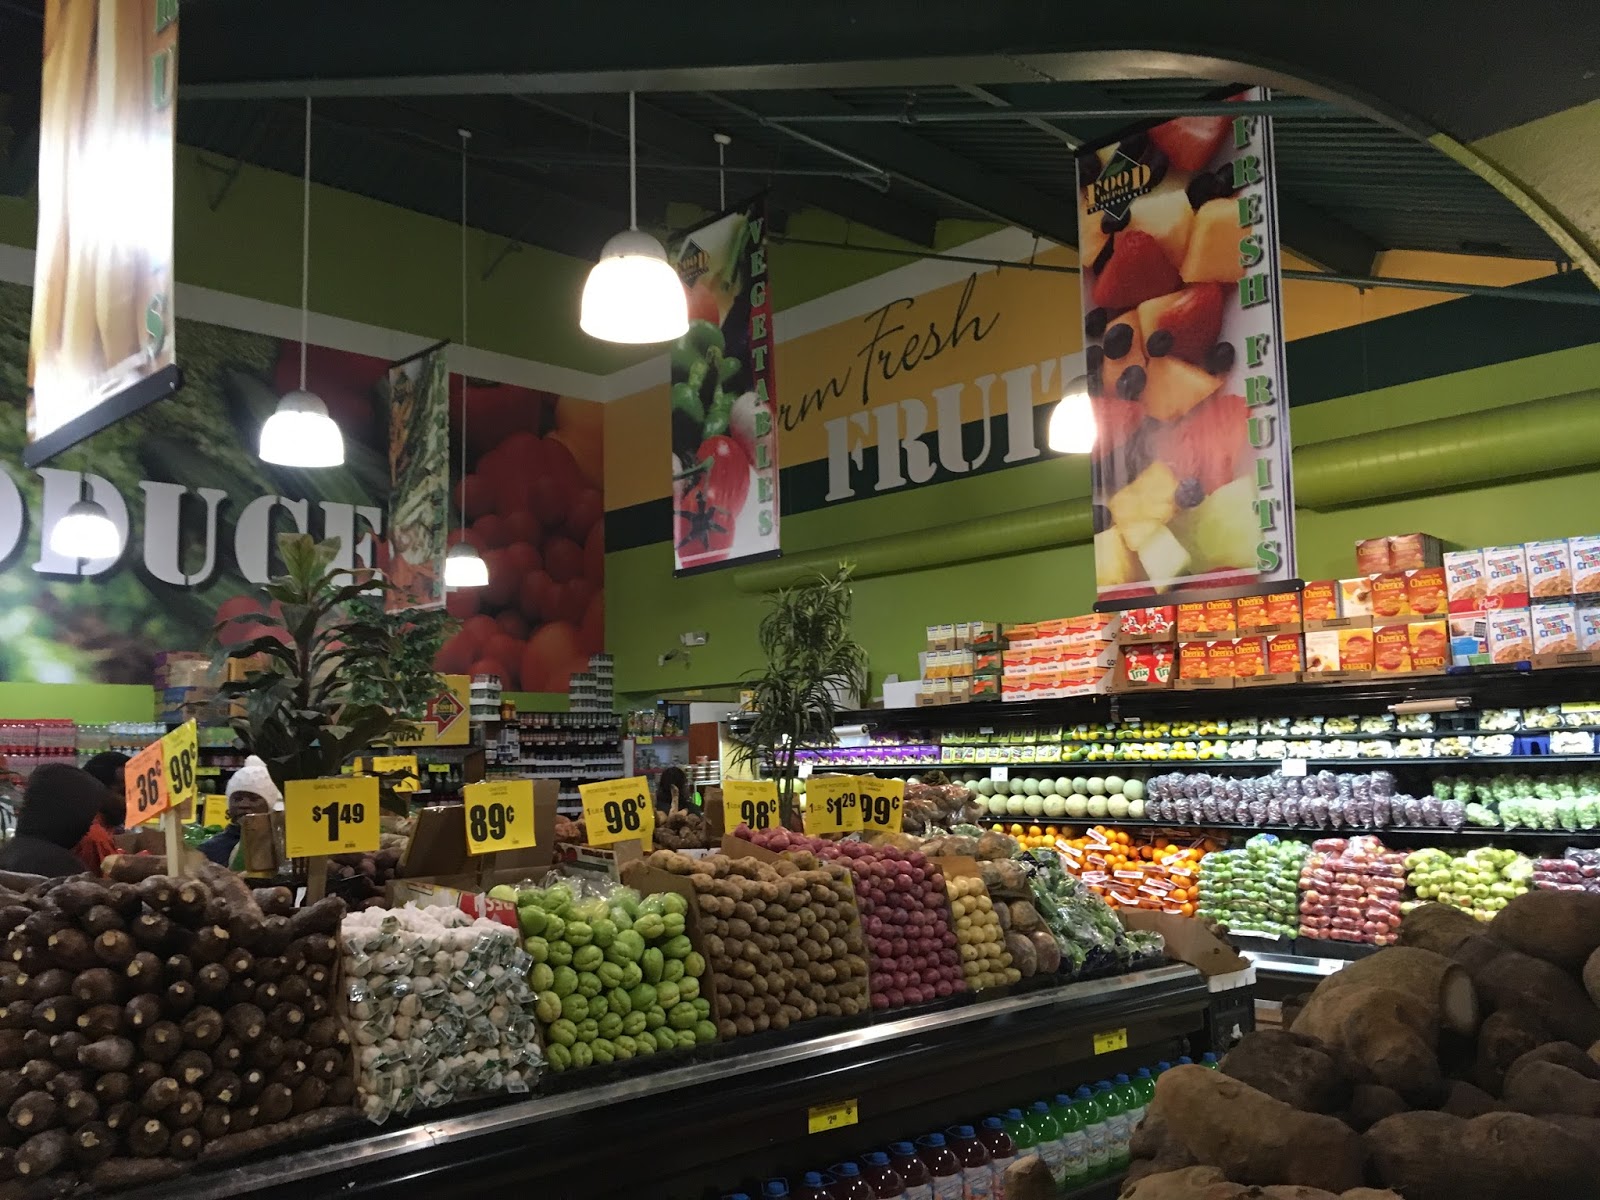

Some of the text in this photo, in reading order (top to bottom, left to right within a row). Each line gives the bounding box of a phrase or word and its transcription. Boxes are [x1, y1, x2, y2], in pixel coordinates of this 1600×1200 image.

[857, 273, 1000, 405] Fresh
[1231, 116, 1282, 573] FRESH FRUITS
[748, 217, 774, 537] VEGETABLES
[1533, 561, 1565, 574] Crunch
[1537, 557, 1558, 567] Toast
[1452, 570, 1481, 583] Crunch
[1491, 566, 1522, 579] Crunch
[1373, 580, 1404, 591] Cheerios
[1410, 577, 1443, 587] Cheerios
[1268, 594, 1296, 602] Cheerios
[1304, 589, 1332, 598] Cheerios
[1237, 598, 1264, 607] Cheerios
[1496, 628, 1527, 641] Crunch
[1540, 624, 1572, 638] Crunch
[1376, 634, 1406, 643] Cheerios
[1235, 645, 1260, 654] Cheerios
[1270, 642, 1296, 651] Cheerios
[1181, 649, 1205, 657] Cheerios
[1130, 668, 1148, 680] Trix
[603, 793, 646, 834] 98¢
[470, 802, 515, 843] 89¢
